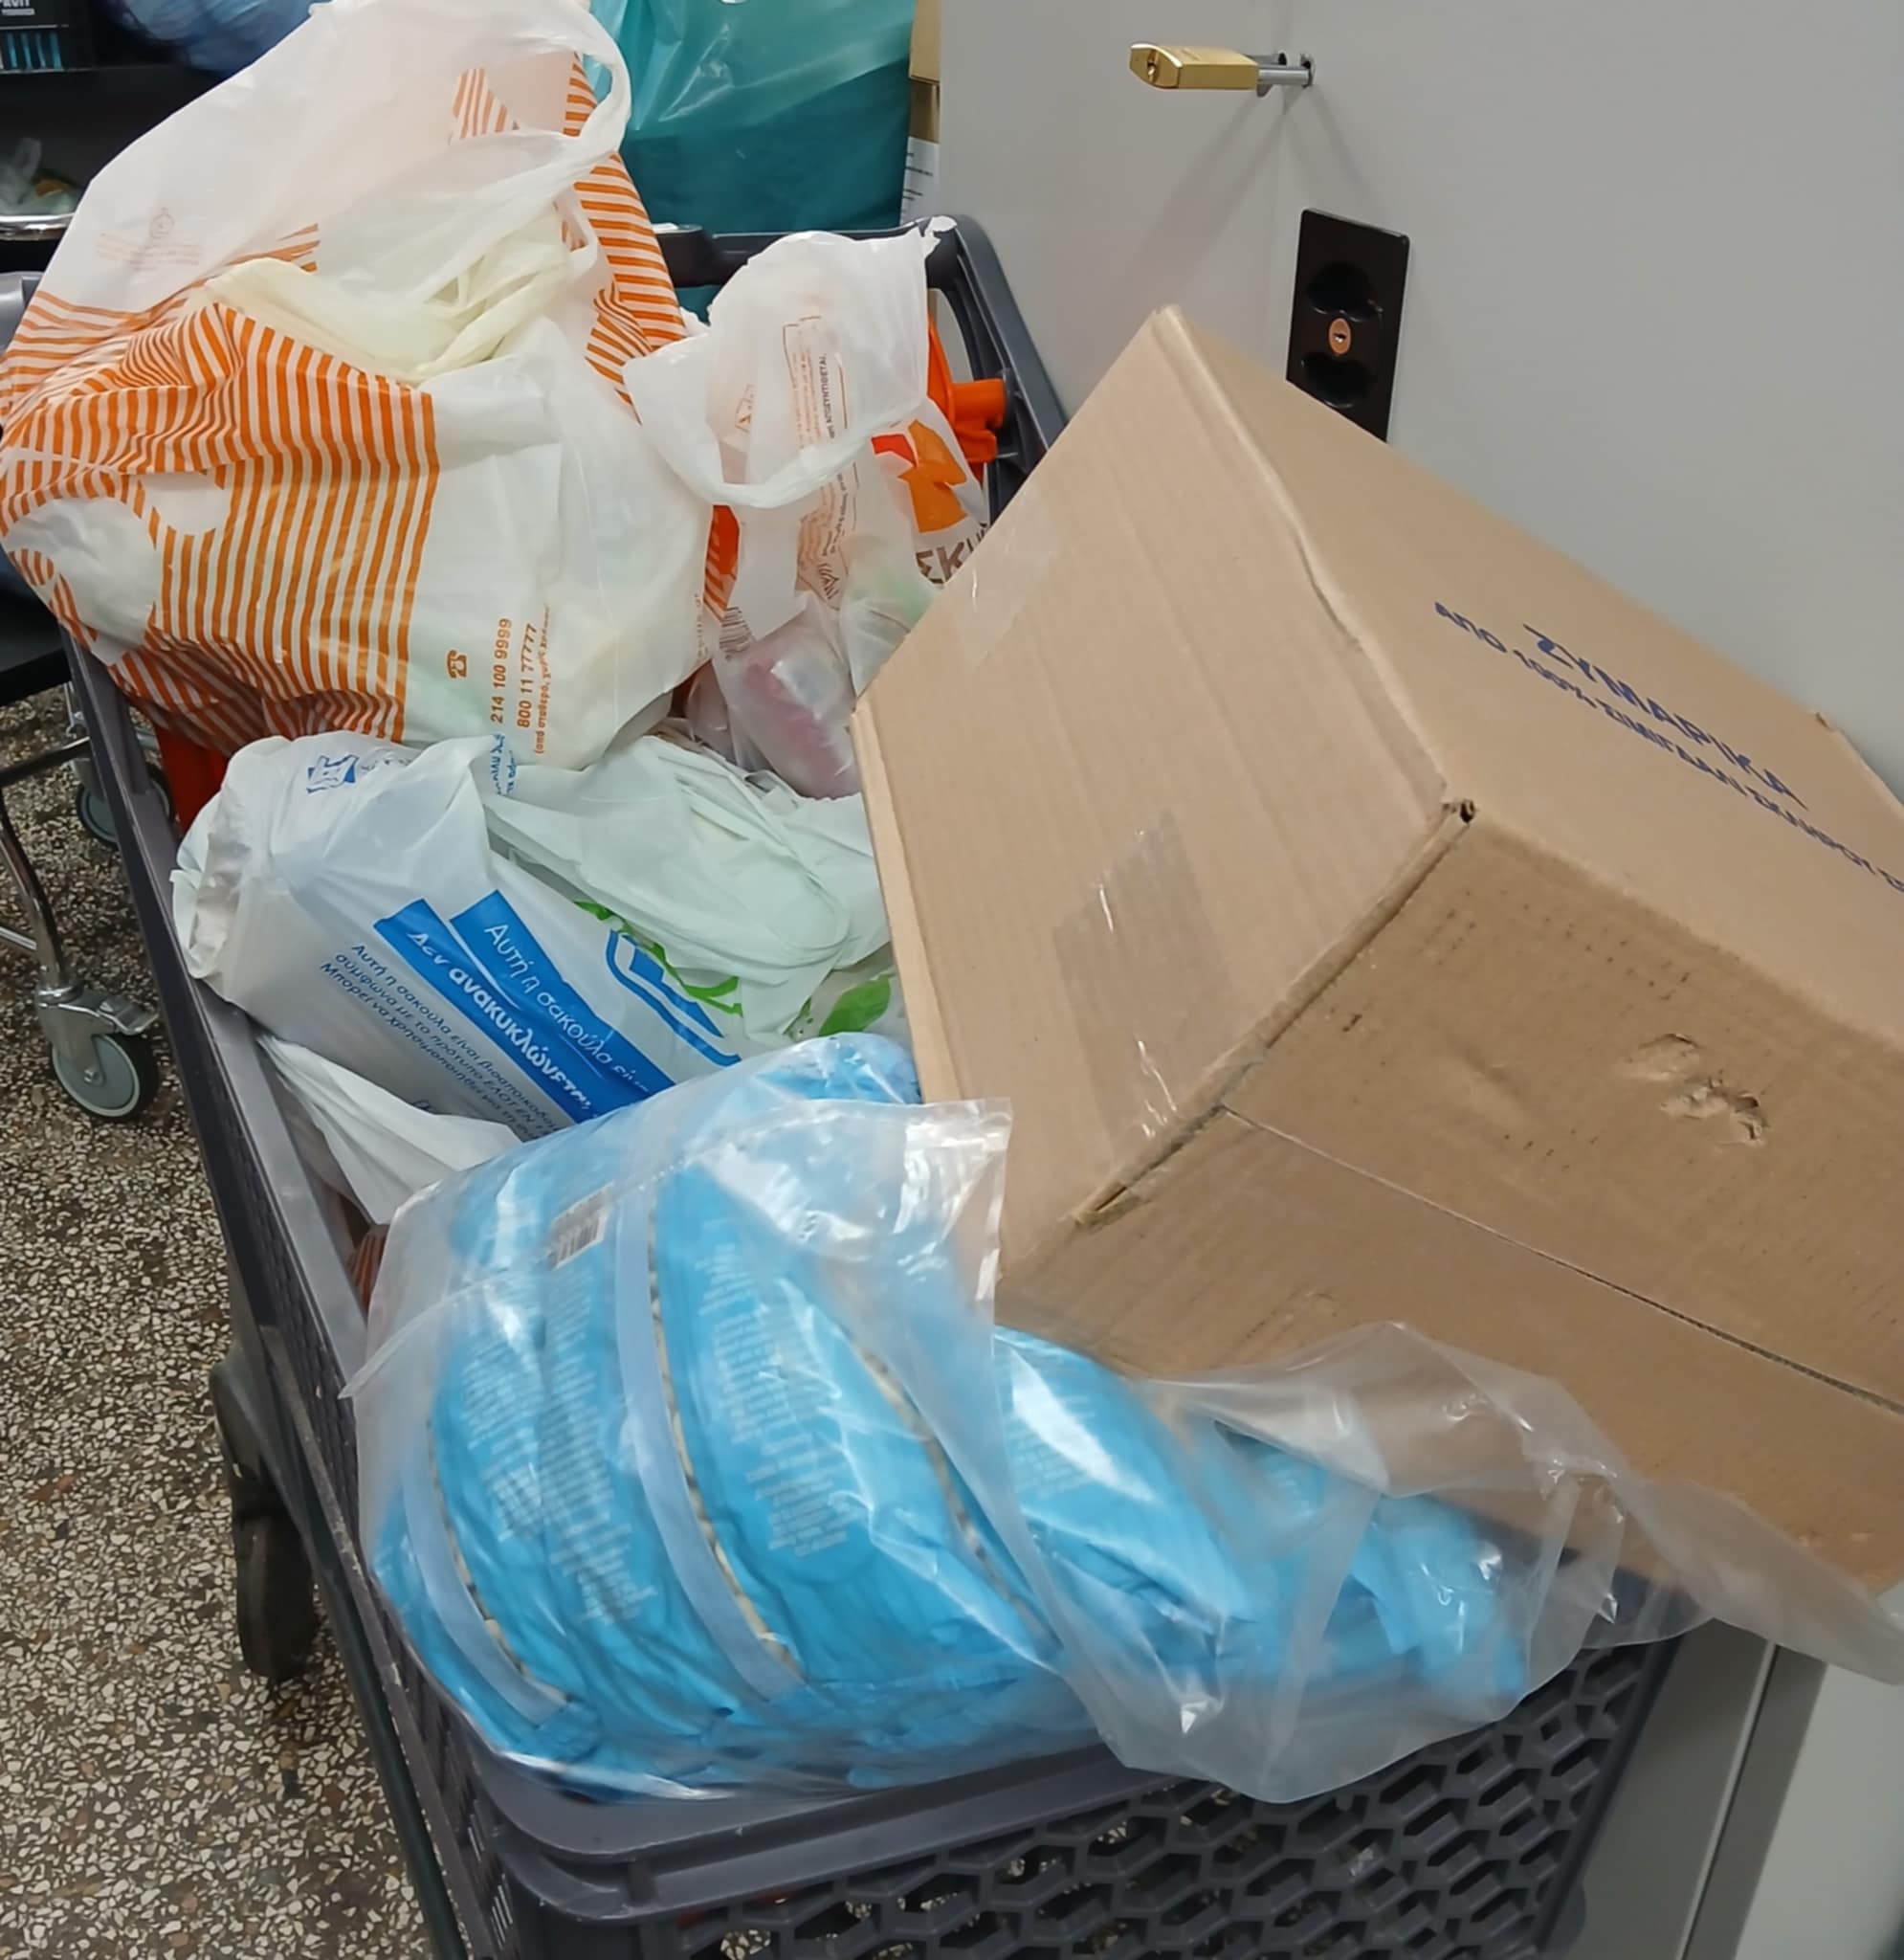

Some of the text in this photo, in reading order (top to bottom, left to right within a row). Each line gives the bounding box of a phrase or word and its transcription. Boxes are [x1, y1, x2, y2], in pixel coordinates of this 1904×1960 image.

[494, 617, 511, 659] 9999
[1435, 602, 1507, 653] ΑΠΟ
[493, 664, 506, 689] 100
[517, 623, 537, 728] 800 11 77777
[490, 696, 504, 724] 214
[1523, 623, 1808, 811] ΖΥΜΑΡΙΚΑ
[351, 945, 387, 977] Αυτή
[386, 975, 397, 987] η
[407, 932, 450, 966] Δεν
[320, 963, 373, 1002] Μπορεί
[373, 1002, 389, 1016] να
[484, 924, 613, 1064] Αυτή η σακούλα
[415, 1020, 431, 1035] το
